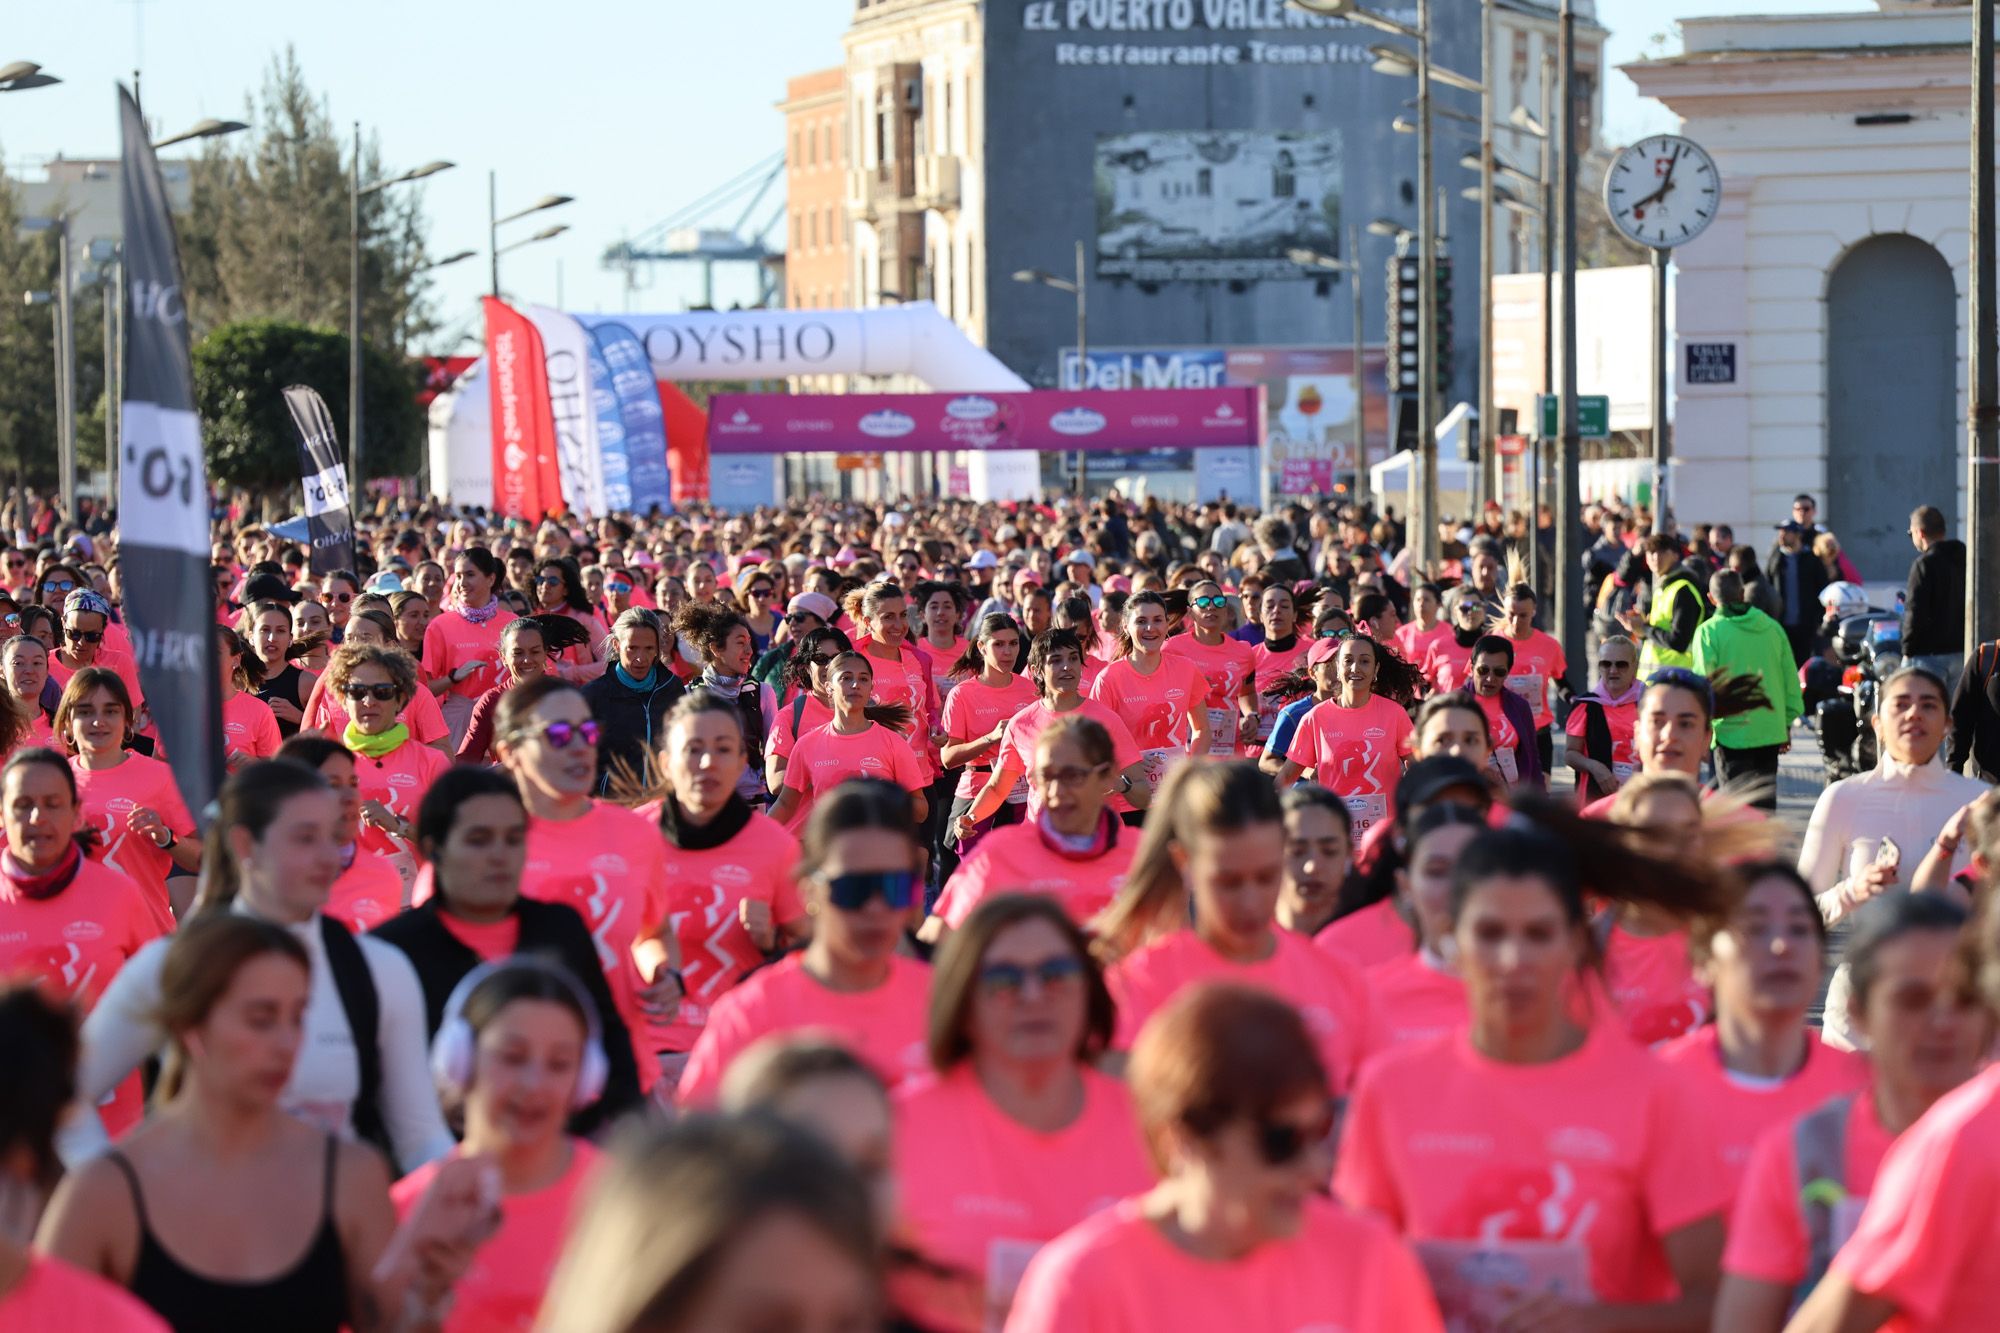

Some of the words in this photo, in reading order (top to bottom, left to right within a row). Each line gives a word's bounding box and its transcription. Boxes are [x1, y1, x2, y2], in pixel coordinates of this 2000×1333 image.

[1023, 1, 1060, 30] EL
[1067, 0, 1194, 30] PUERTO
[642, 322, 836, 366] OYSHO
[1066, 352, 1132, 390] Del
[1141, 354, 1226, 389] Mar
[1123, 695, 1148, 703] OYSHO
[814, 759, 840, 768] OYSHO
